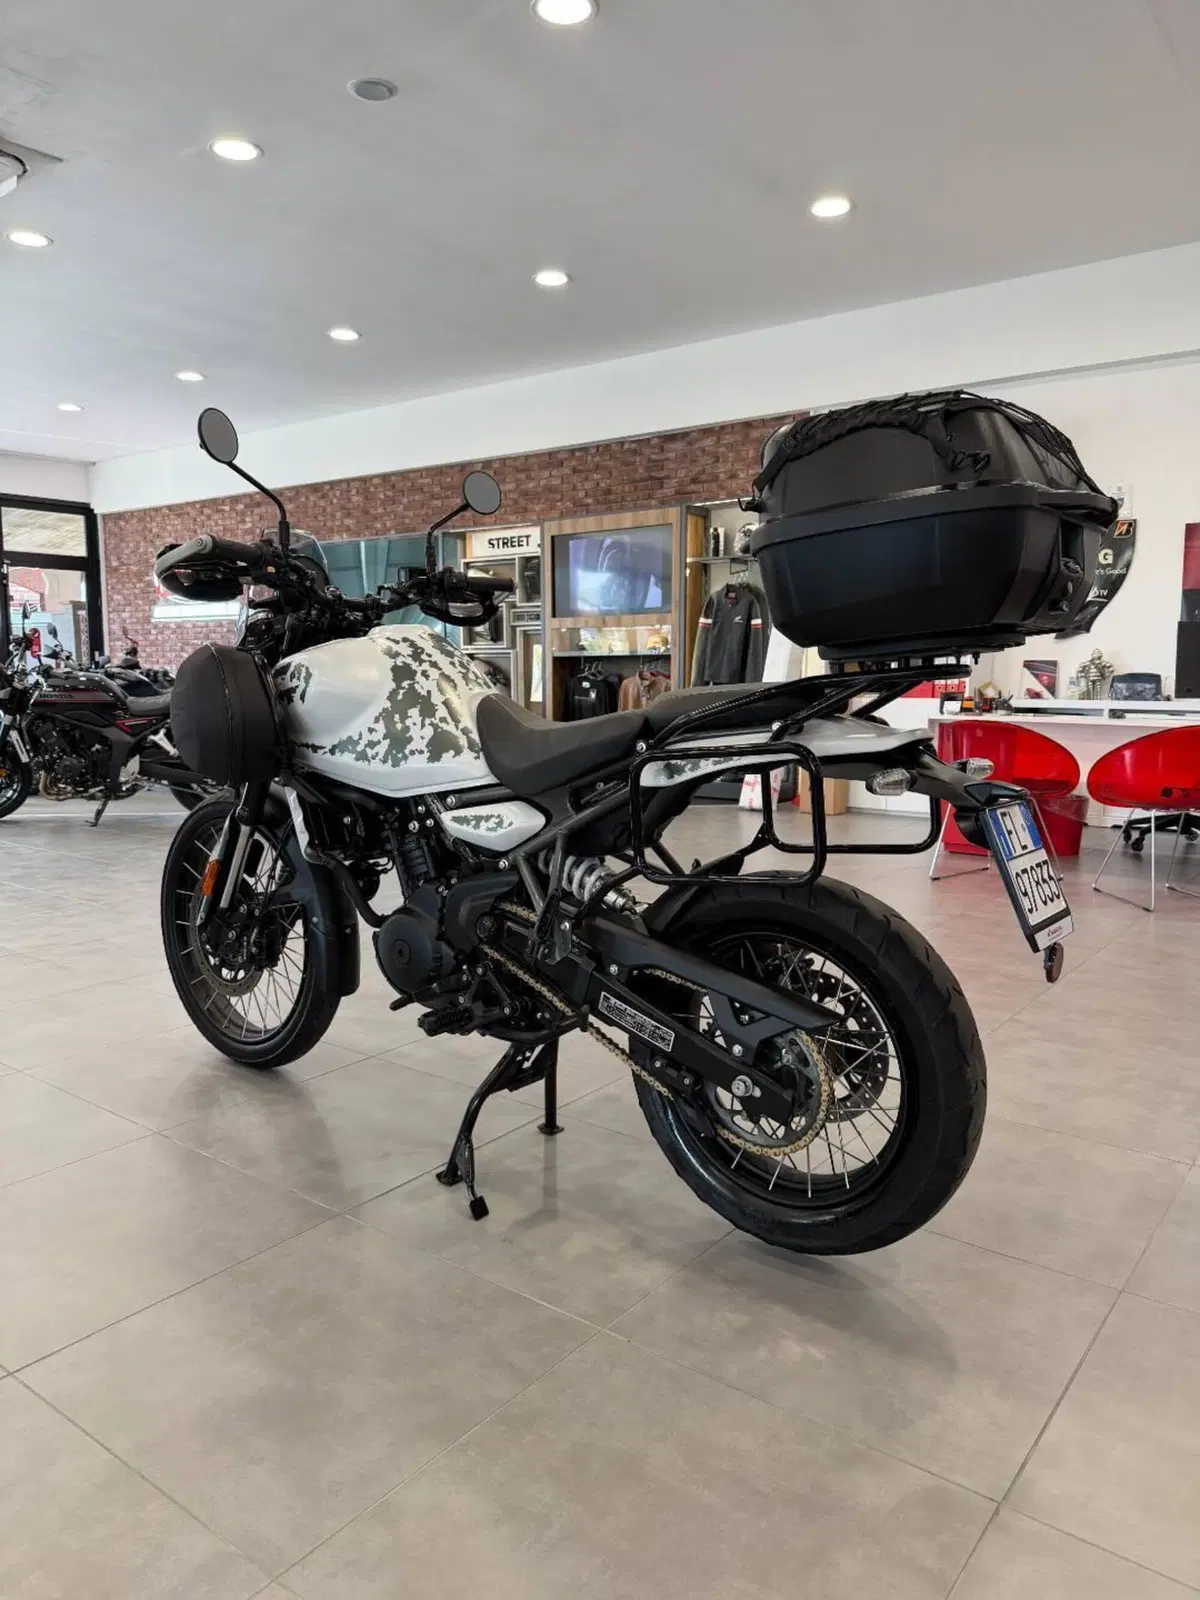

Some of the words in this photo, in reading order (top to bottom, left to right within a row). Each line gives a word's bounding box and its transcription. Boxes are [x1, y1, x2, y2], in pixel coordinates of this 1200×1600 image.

[488, 534, 531, 549] STREET
[1000, 809, 1029, 855] FL
[1014, 859, 1061, 915] 97833
